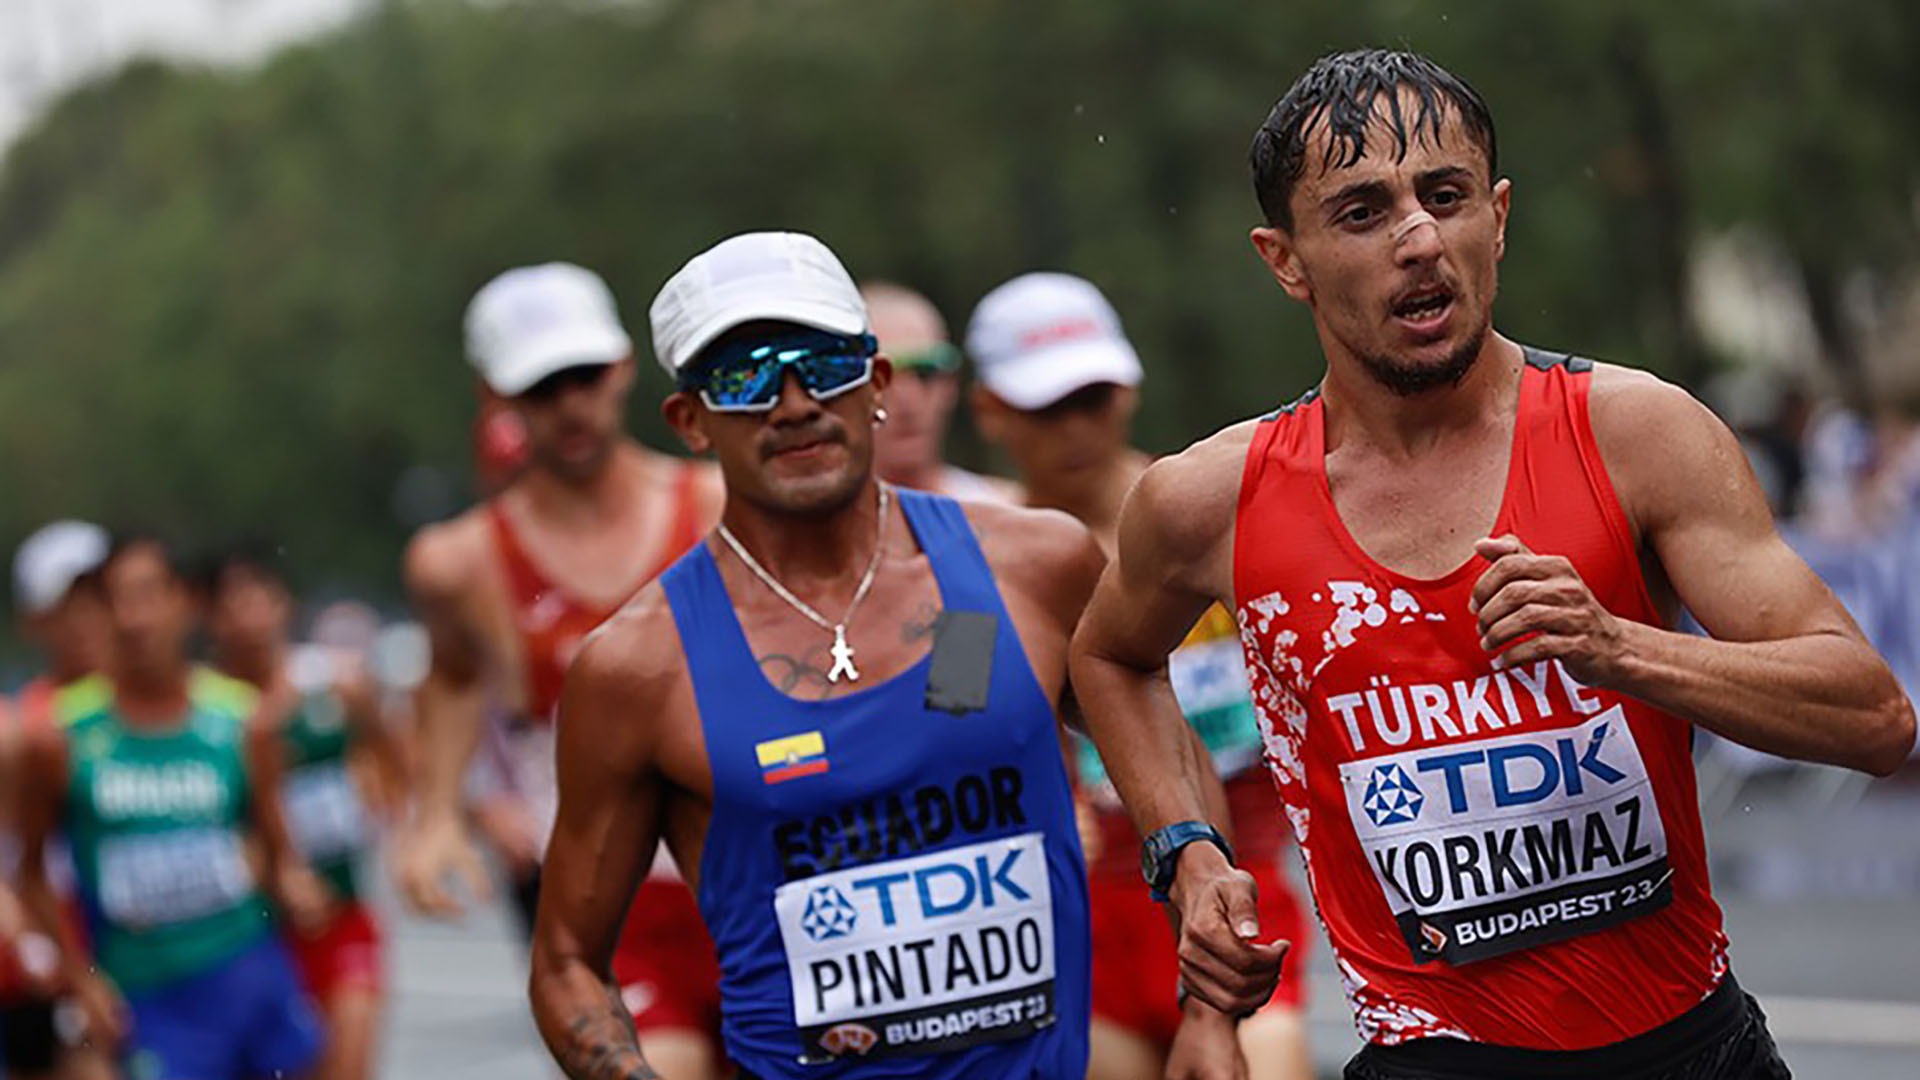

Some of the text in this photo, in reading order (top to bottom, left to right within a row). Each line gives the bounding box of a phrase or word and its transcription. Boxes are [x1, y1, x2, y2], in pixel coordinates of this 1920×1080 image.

[1417, 722, 1626, 815] TDK
[774, 766, 1026, 880] ECUADOR
[853, 849, 1031, 926] TDK
[1455, 879, 1653, 945] BUDAPEST 23
[810, 917, 1043, 1013] PINTADO
[886, 1000, 1023, 1045] BUDAPEST
